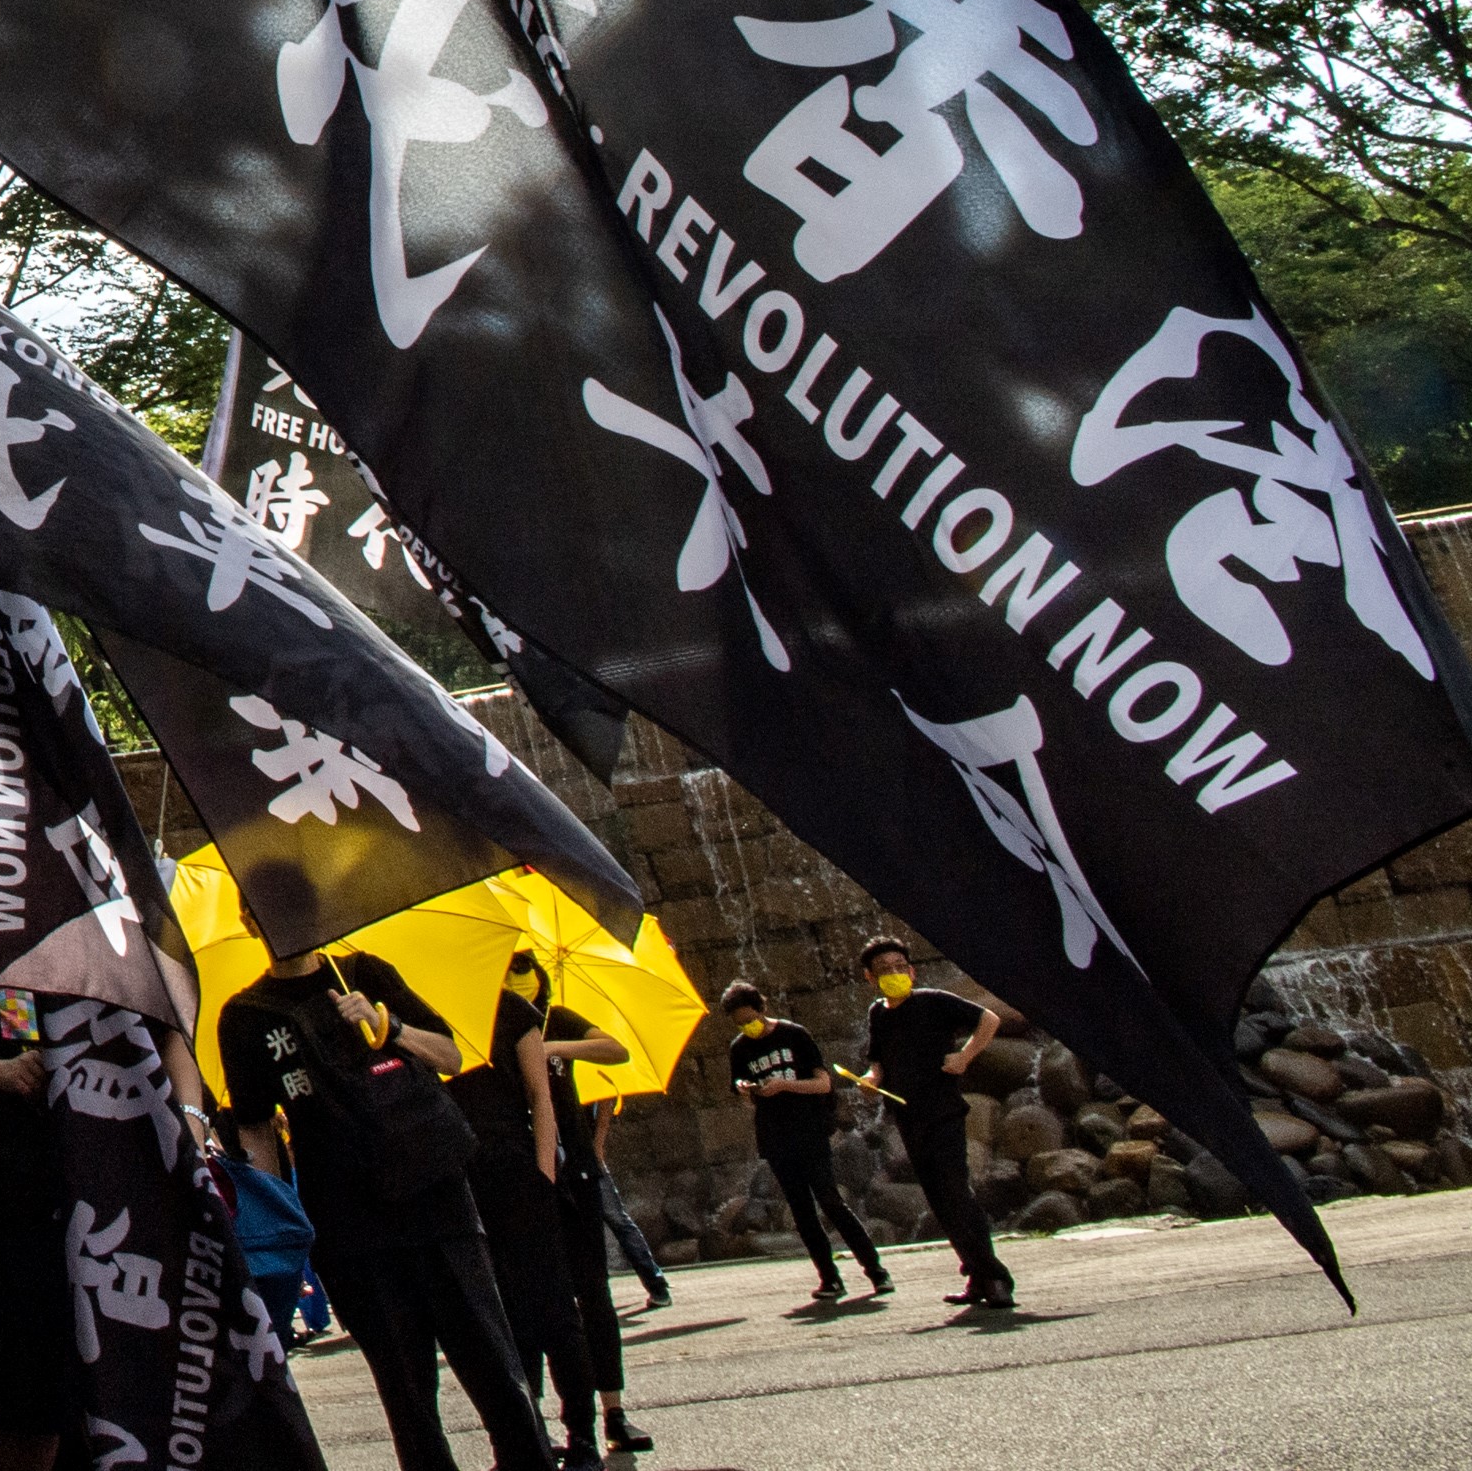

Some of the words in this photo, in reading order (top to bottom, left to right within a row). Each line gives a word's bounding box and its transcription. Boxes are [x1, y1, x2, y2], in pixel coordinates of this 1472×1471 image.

[251, 402, 305, 445] FREE
[616, 147, 1082, 635] REVOLUTION
[1047, 597, 1299, 815] NOW
